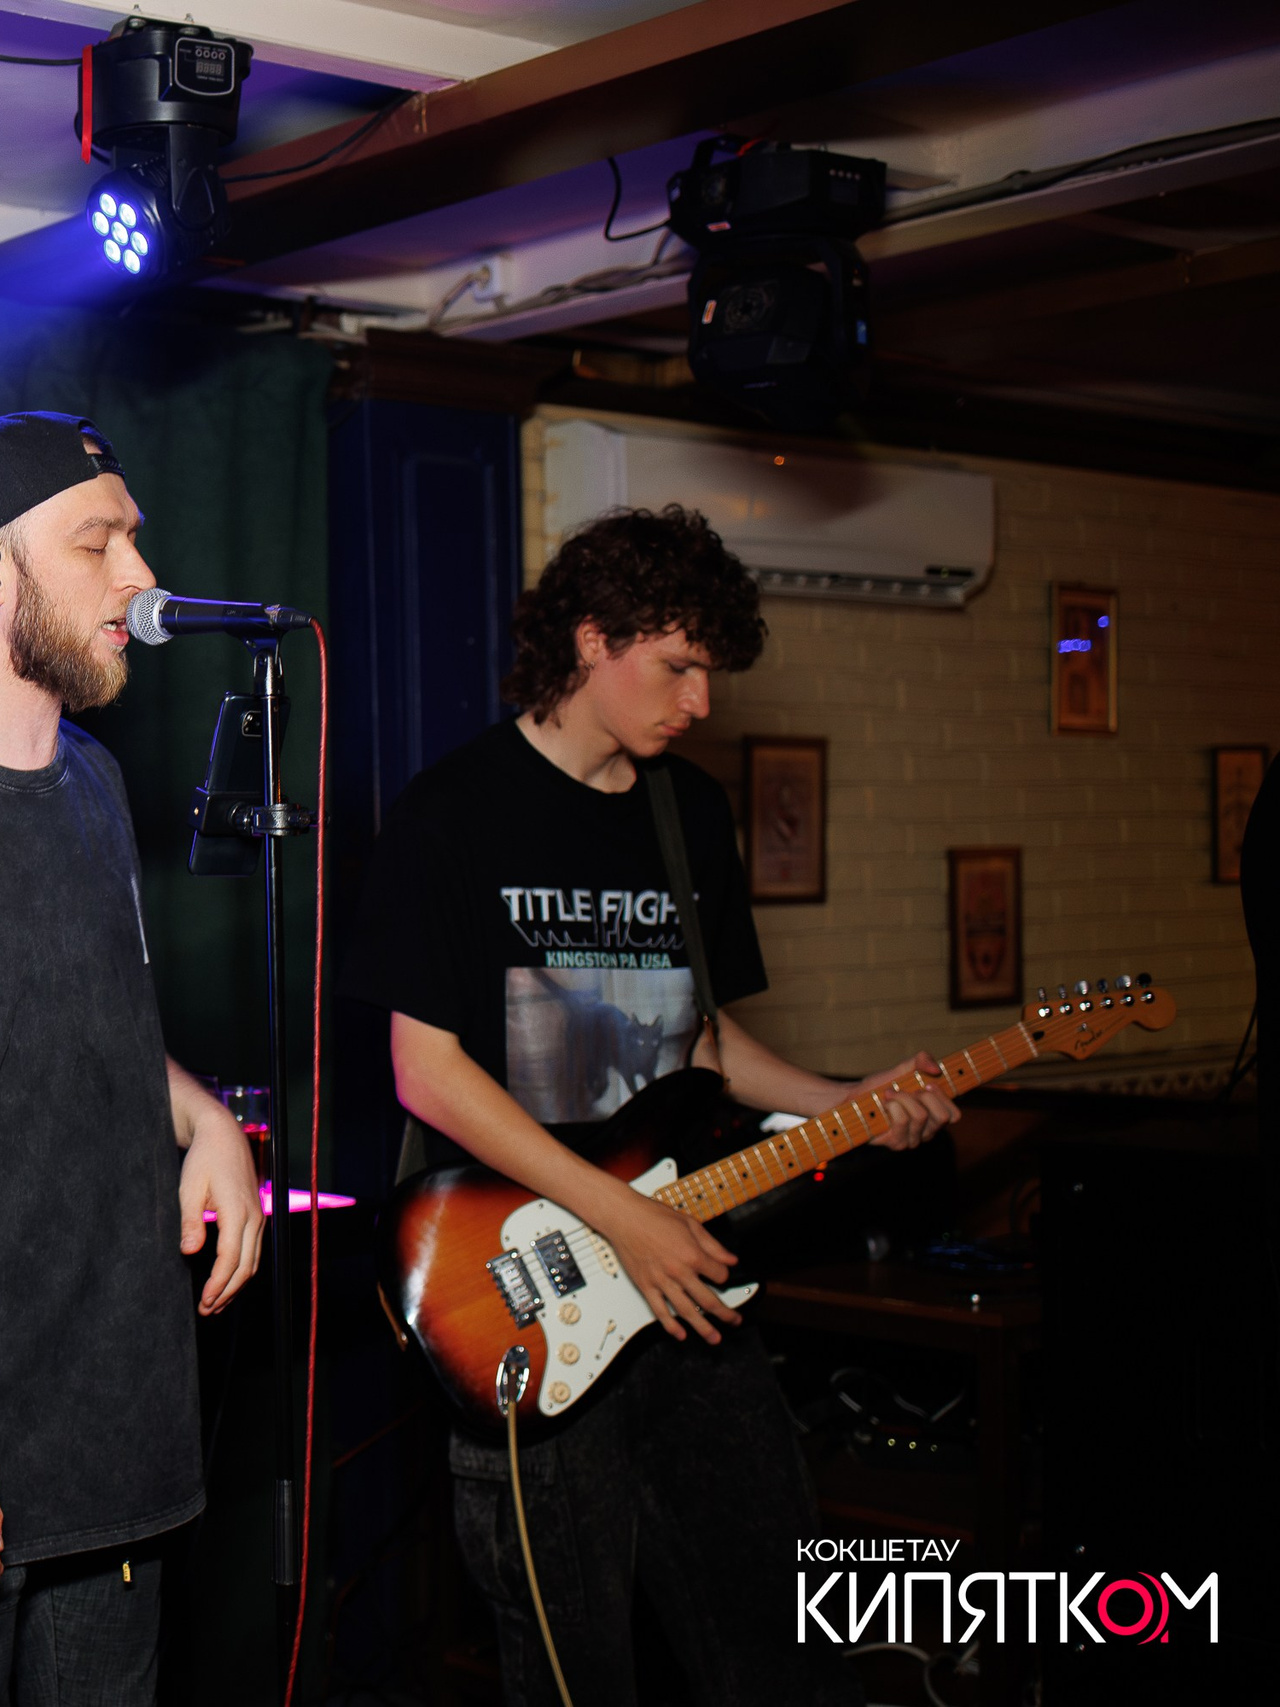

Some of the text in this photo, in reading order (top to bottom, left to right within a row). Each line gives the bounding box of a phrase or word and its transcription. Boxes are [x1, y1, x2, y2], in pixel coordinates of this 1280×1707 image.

[501, 887, 699, 926] TITLE FIGH
[545, 951, 672, 968] KINGSTON PA USA
